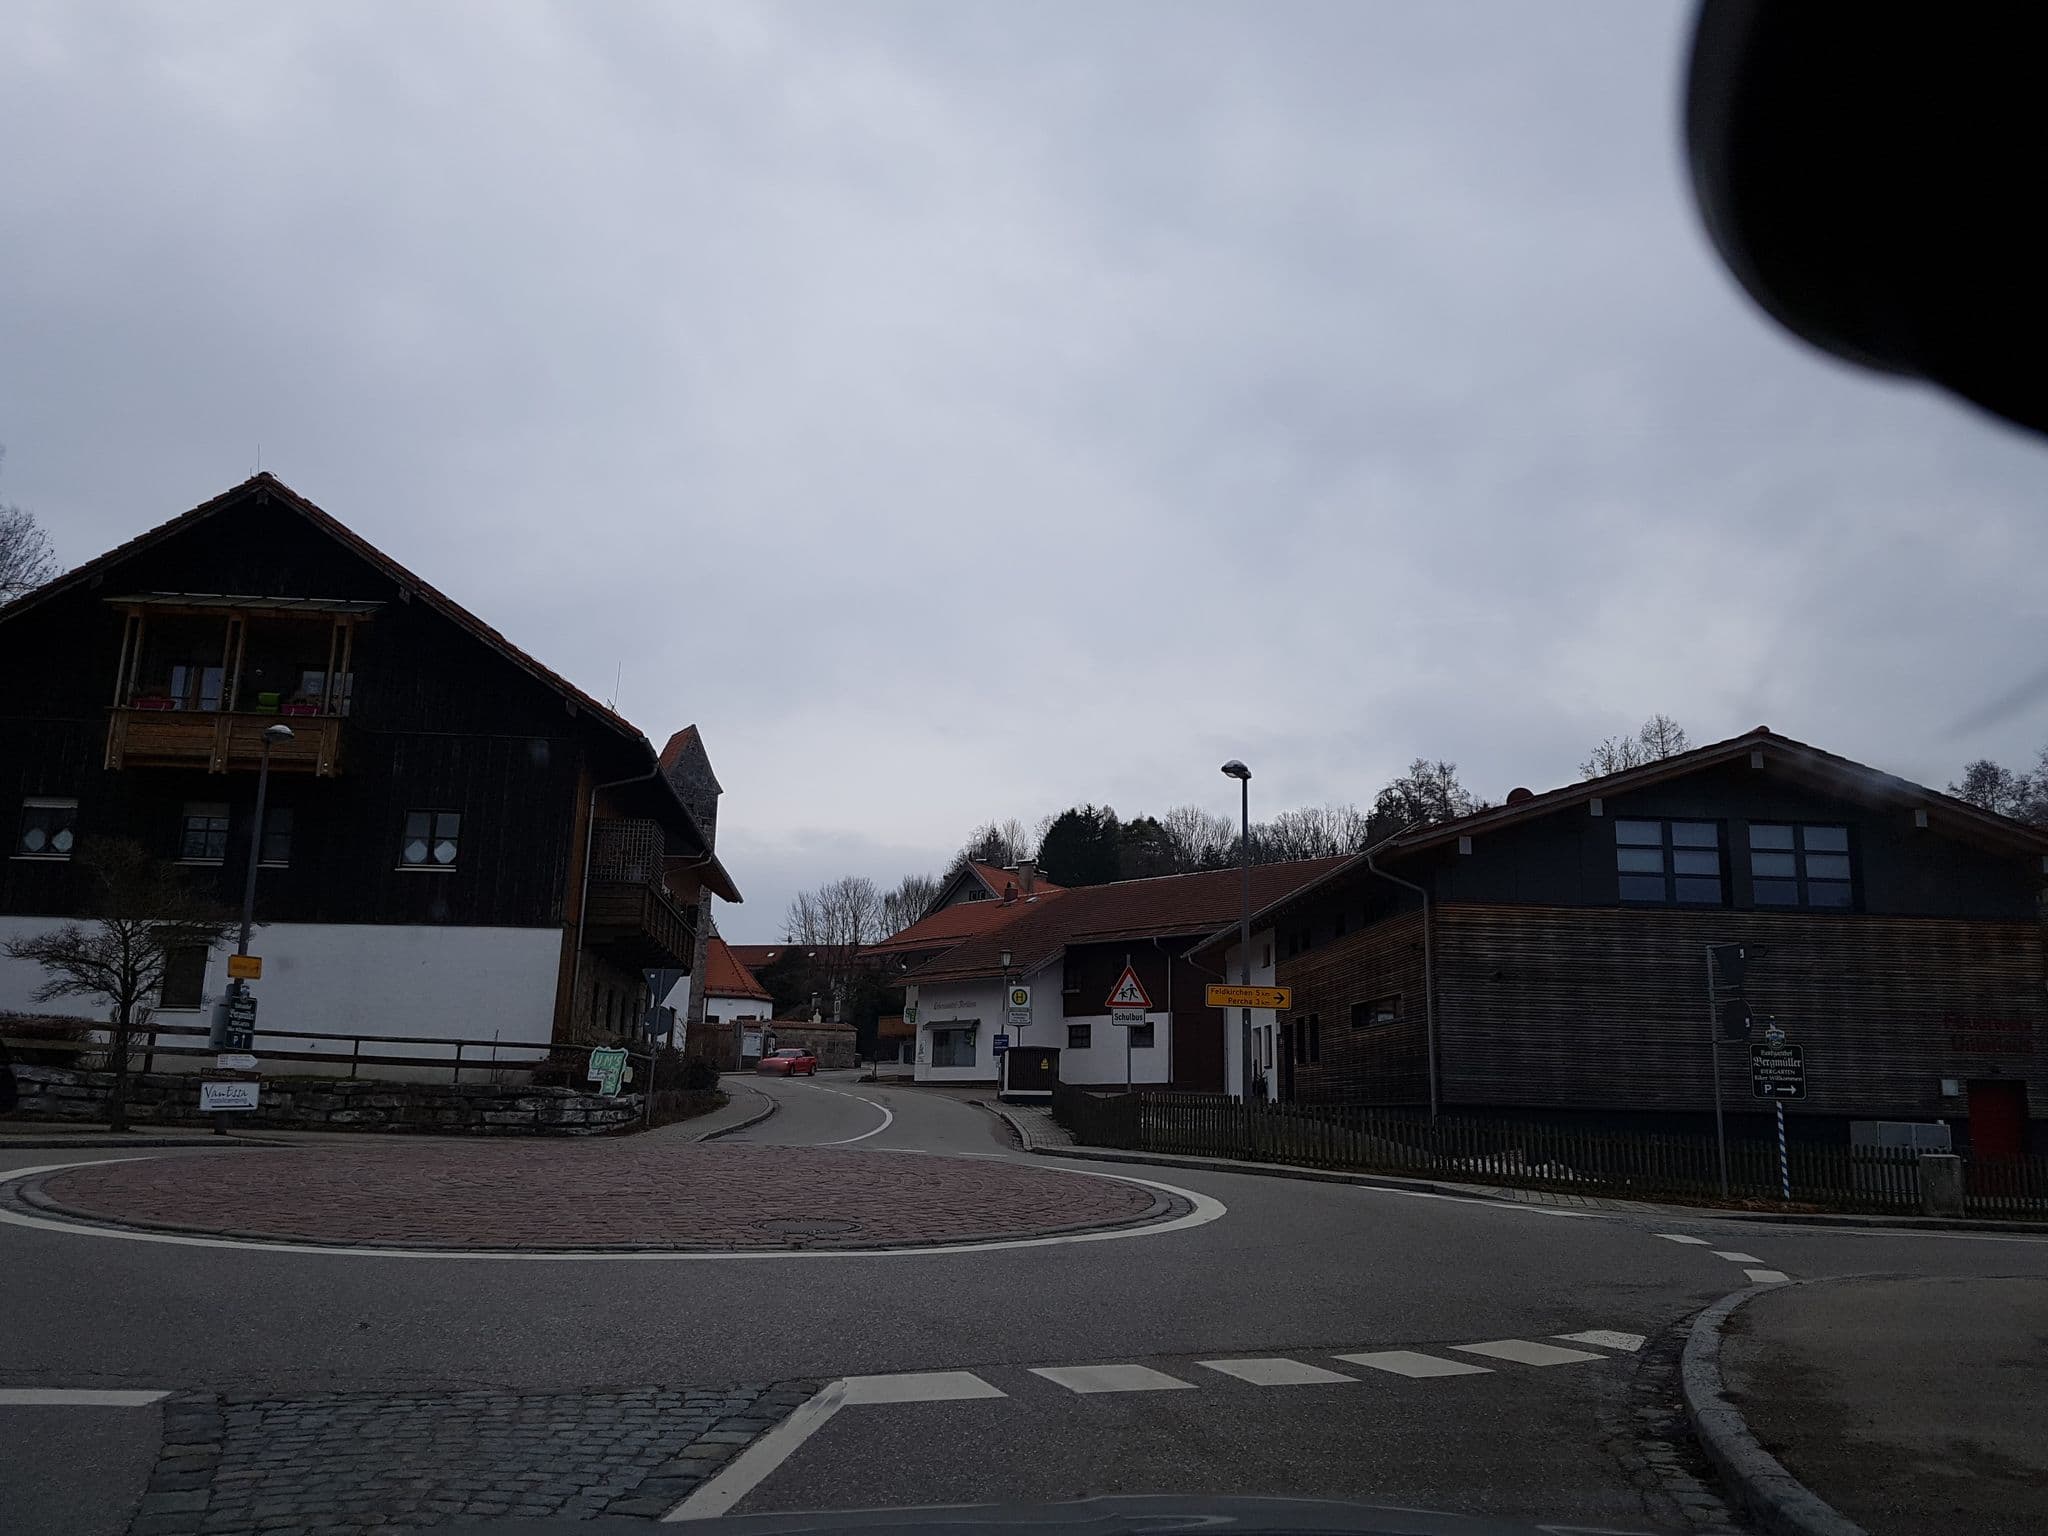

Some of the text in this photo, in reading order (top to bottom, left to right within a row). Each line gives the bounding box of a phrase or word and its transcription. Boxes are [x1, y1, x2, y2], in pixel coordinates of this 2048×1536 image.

[1211, 987, 1253, 996] Feldkirchen
[1256, 989, 1261, 997] 5
[1114, 1012, 1143, 1022] Schulbus
[1764, 1084, 1773, 1094] P
